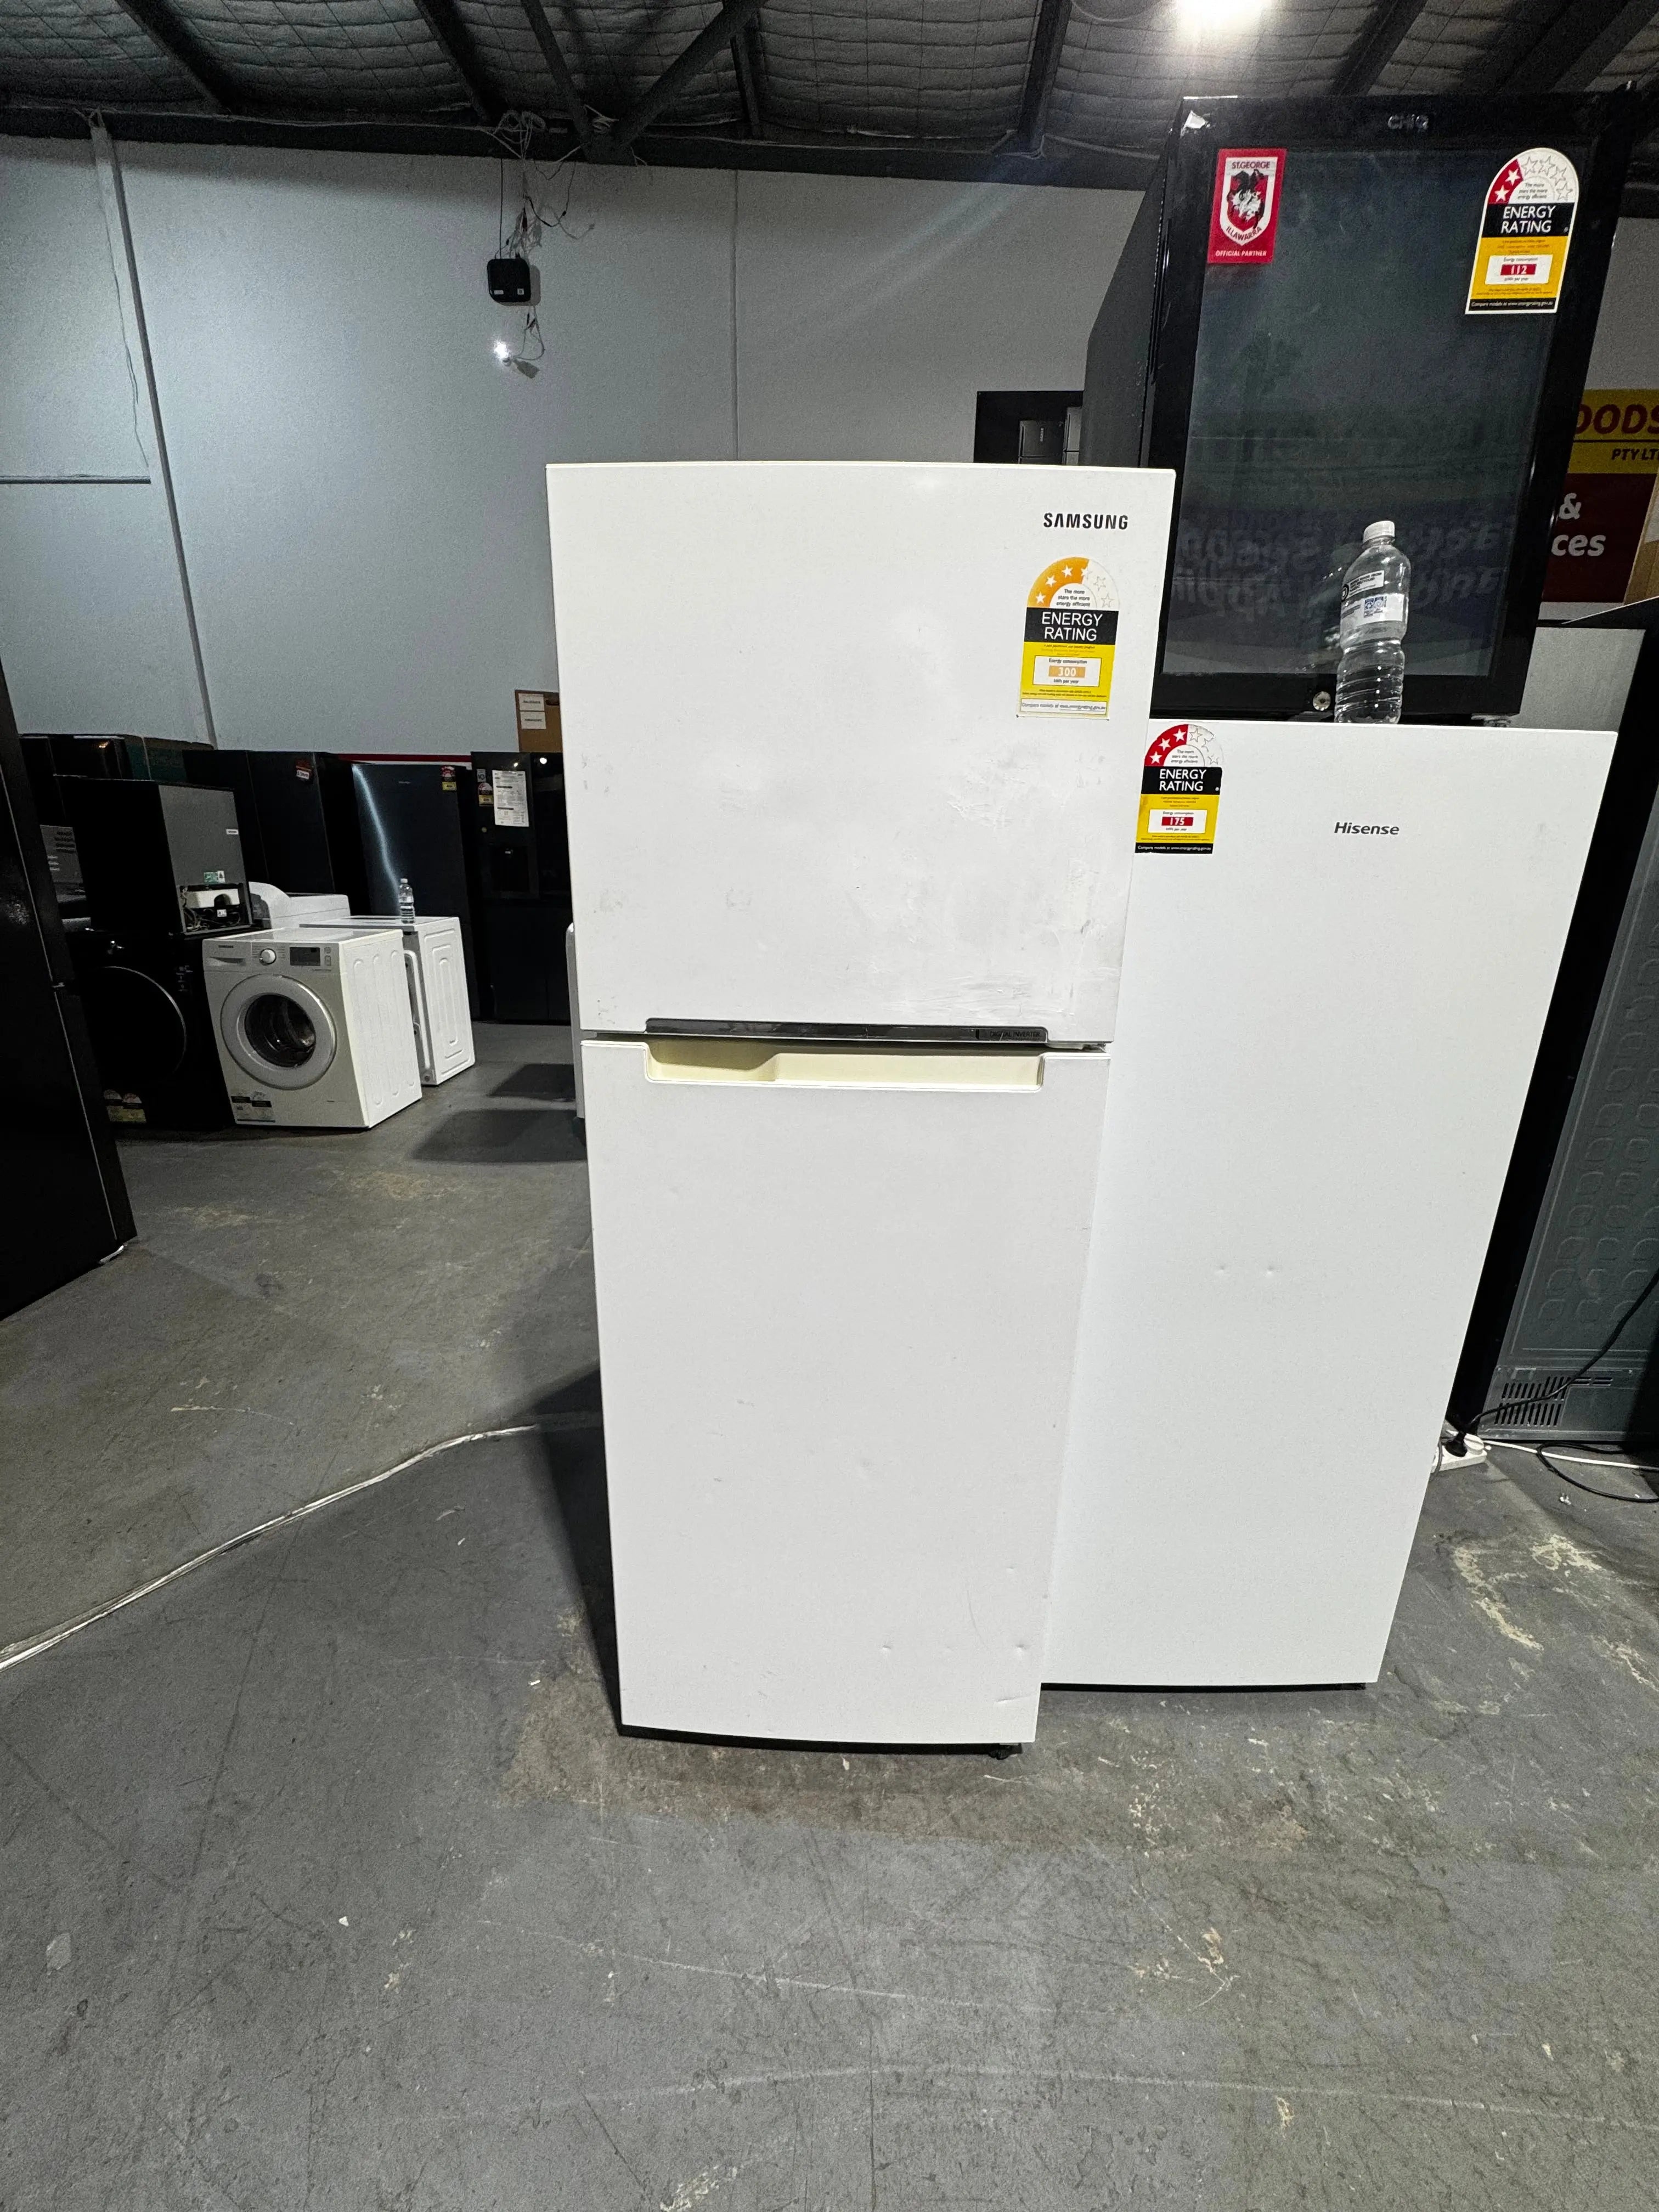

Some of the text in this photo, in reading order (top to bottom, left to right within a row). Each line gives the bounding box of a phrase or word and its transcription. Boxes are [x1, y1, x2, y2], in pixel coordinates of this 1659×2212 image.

[1503, 206, 1556, 219] ENERGY
[1226, 226, 1262, 240] ILLAWARRA
[1500, 220, 1552, 233] RATING
[1511, 265, 1527, 274] 112
[1611, 448, 1659, 460] PTY LT
[1559, 493, 1581, 520] &
[1043, 512, 1128, 530] SAMSUNG
[1042, 612, 1103, 626] ENERGY
[1044, 627, 1097, 641] RATING
[1058, 667, 1076, 676] 300
[1159, 769, 1207, 780] ENERGY
[1159, 781, 1204, 792] RATING
[1334, 822, 1400, 835] Hisense
